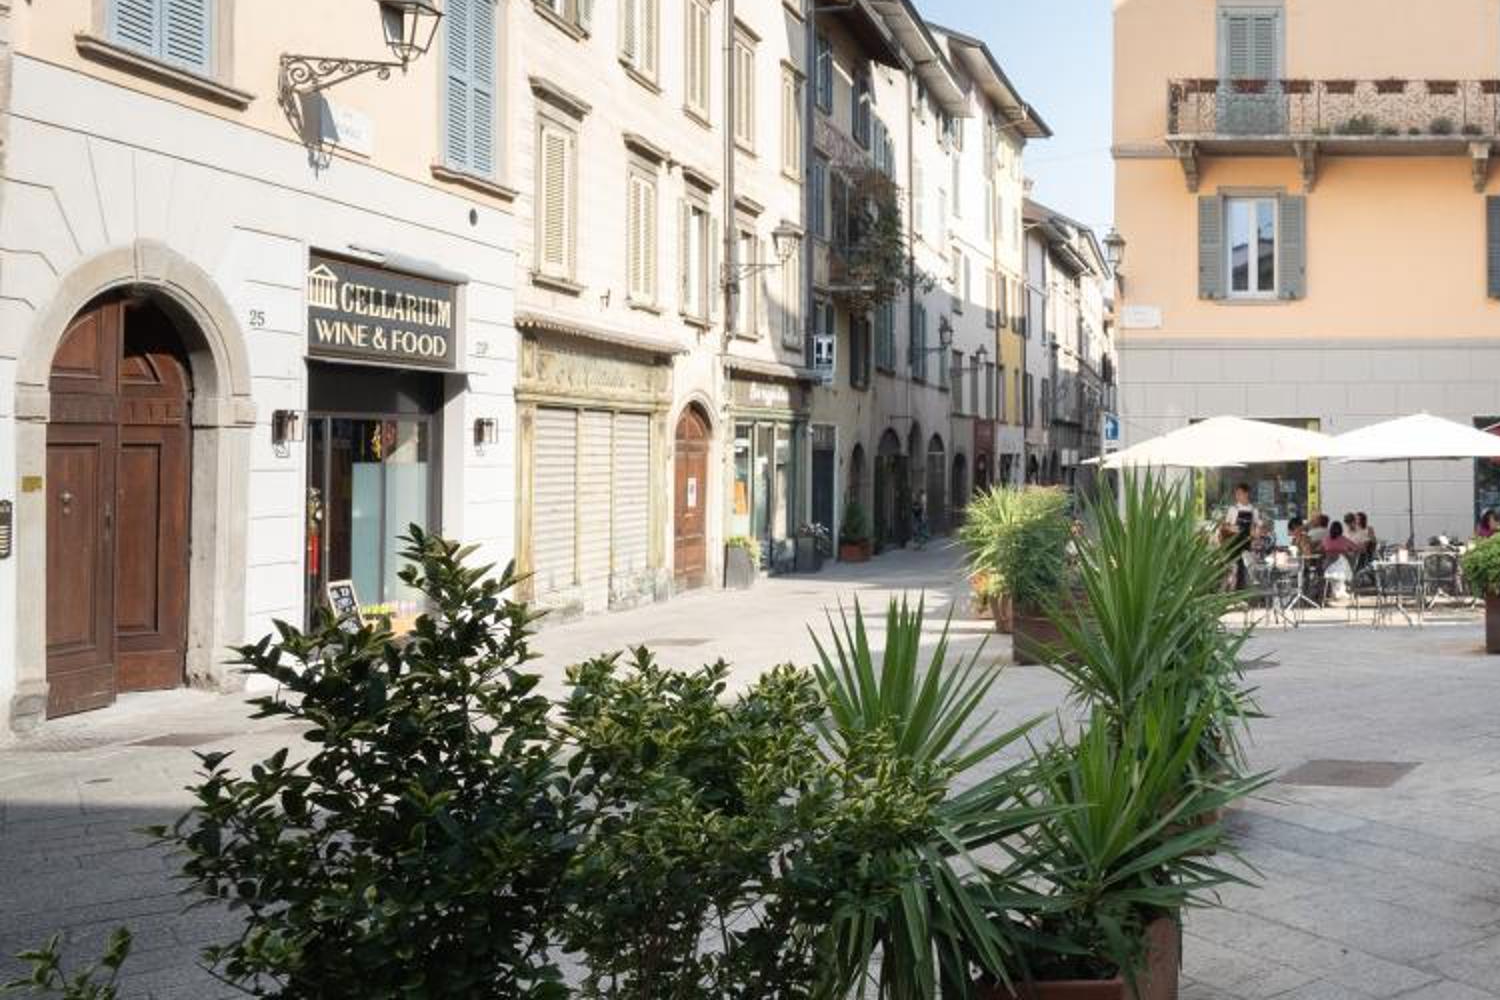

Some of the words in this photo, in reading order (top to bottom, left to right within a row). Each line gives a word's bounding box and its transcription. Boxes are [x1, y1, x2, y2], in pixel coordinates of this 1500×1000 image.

[249, 310, 265, 327] 25
[341, 282, 451, 329] CELLARIUM
[315, 318, 369, 347] WINE
[373, 327, 387, 350] &
[391, 331, 447, 357] FOOD
